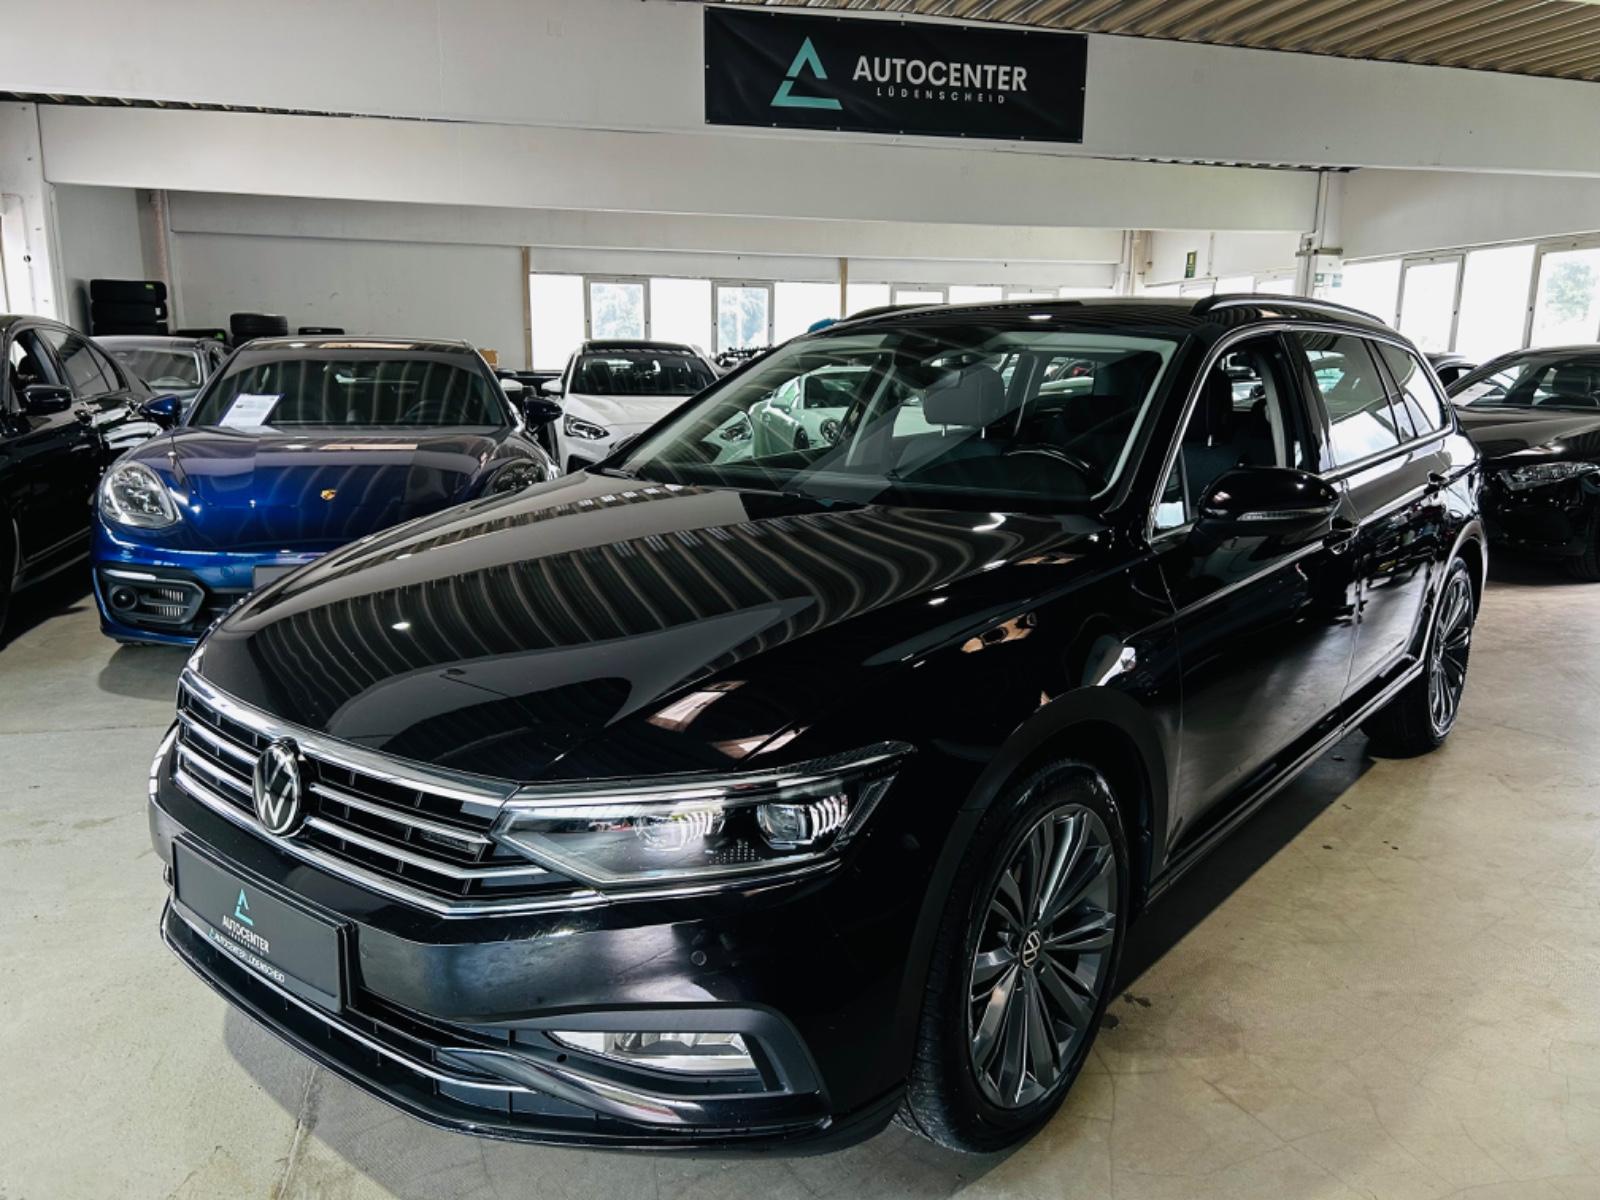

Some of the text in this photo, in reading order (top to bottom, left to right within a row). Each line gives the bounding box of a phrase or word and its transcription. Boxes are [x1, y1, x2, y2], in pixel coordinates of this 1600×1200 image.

[852, 55, 1027, 92] AUTOCENTER
[876, 86, 1005, 104] LÜDENSCHEID
[222, 914, 270, 954] AUTOCENTER
